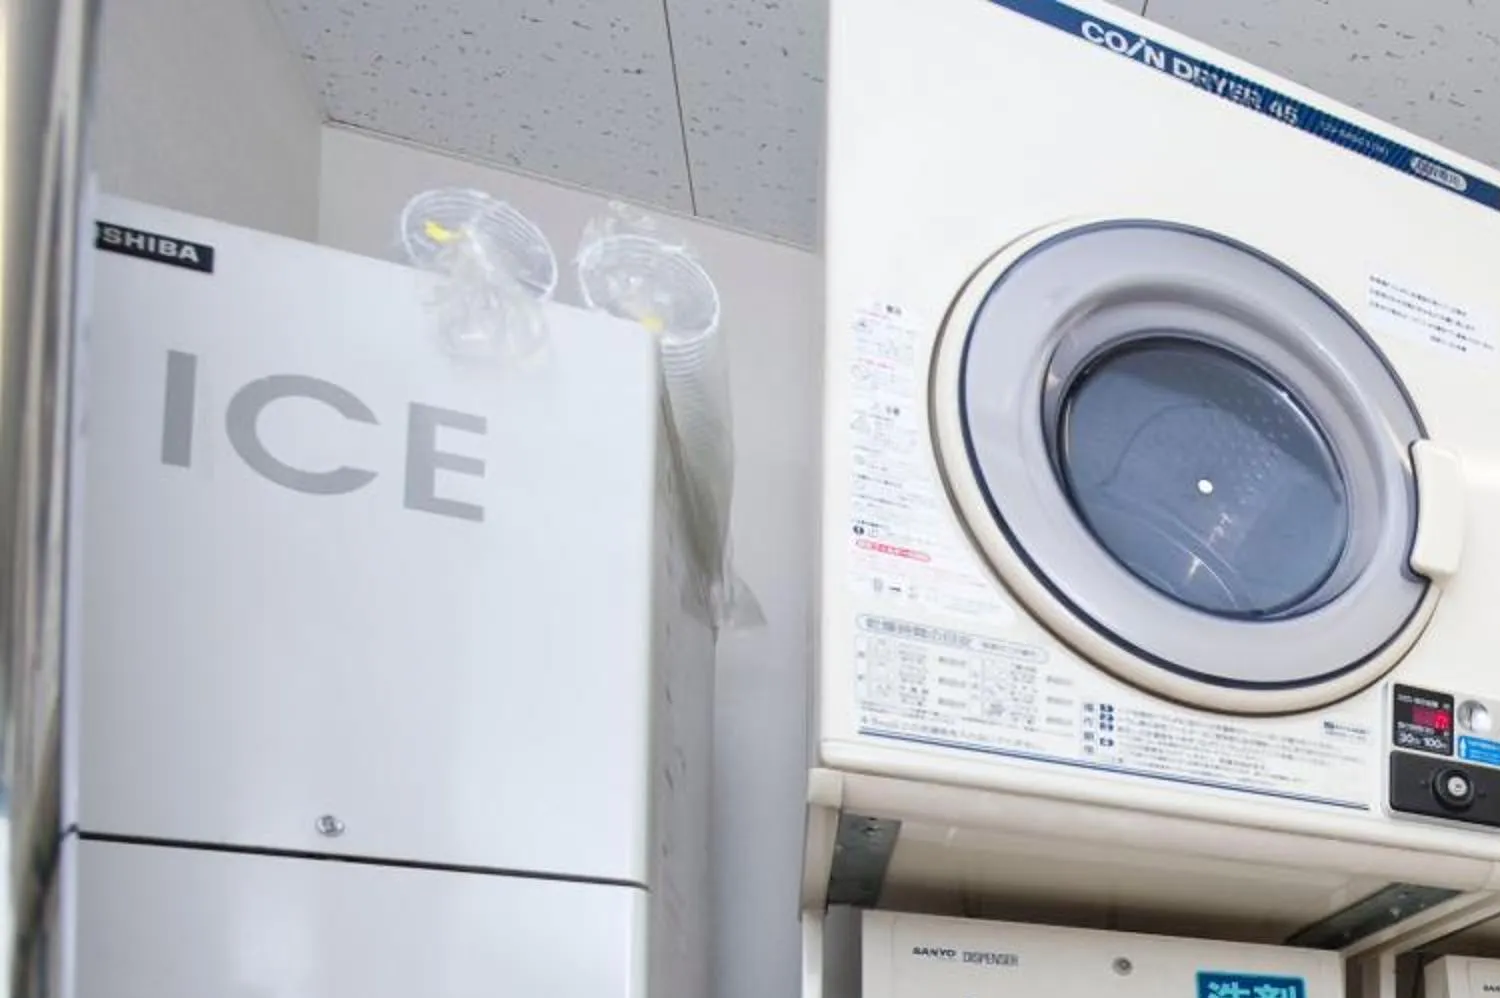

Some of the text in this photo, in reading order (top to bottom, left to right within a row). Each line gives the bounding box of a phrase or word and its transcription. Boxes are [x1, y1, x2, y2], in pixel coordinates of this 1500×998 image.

[1173, 57, 1263, 110] DRYER
[1267, 97, 1300, 126] 45
[96, 222, 200, 264] SHIBA
[160, 349, 488, 523] ICE
[911, 946, 958, 959] SANYO
